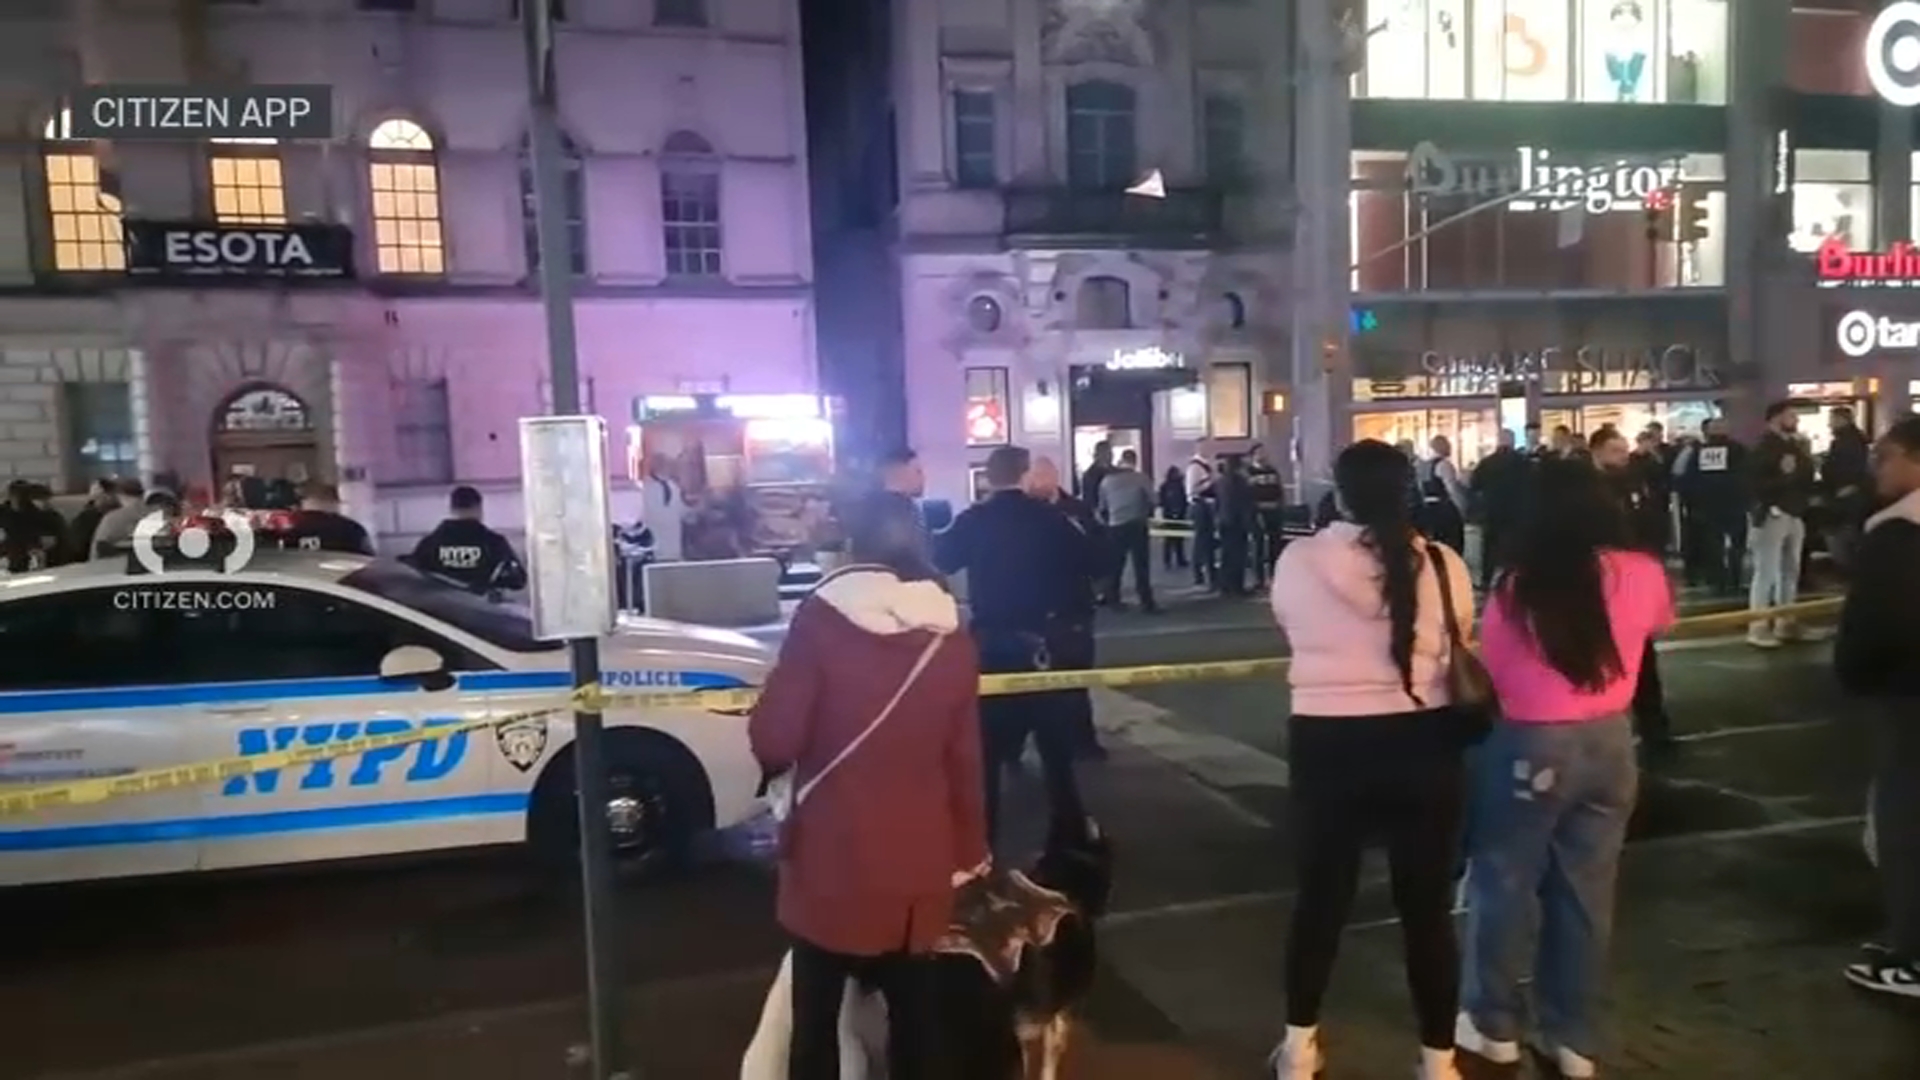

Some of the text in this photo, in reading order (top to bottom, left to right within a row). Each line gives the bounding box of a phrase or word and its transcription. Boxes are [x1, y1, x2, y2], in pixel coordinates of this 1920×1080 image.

[165, 231, 313, 265] ESOTA
[1817, 236, 1920, 279] Burli
[439, 546, 481, 561] NYPD
[606, 671, 679, 686] POLICE
[222, 717, 468, 796] NYPD
